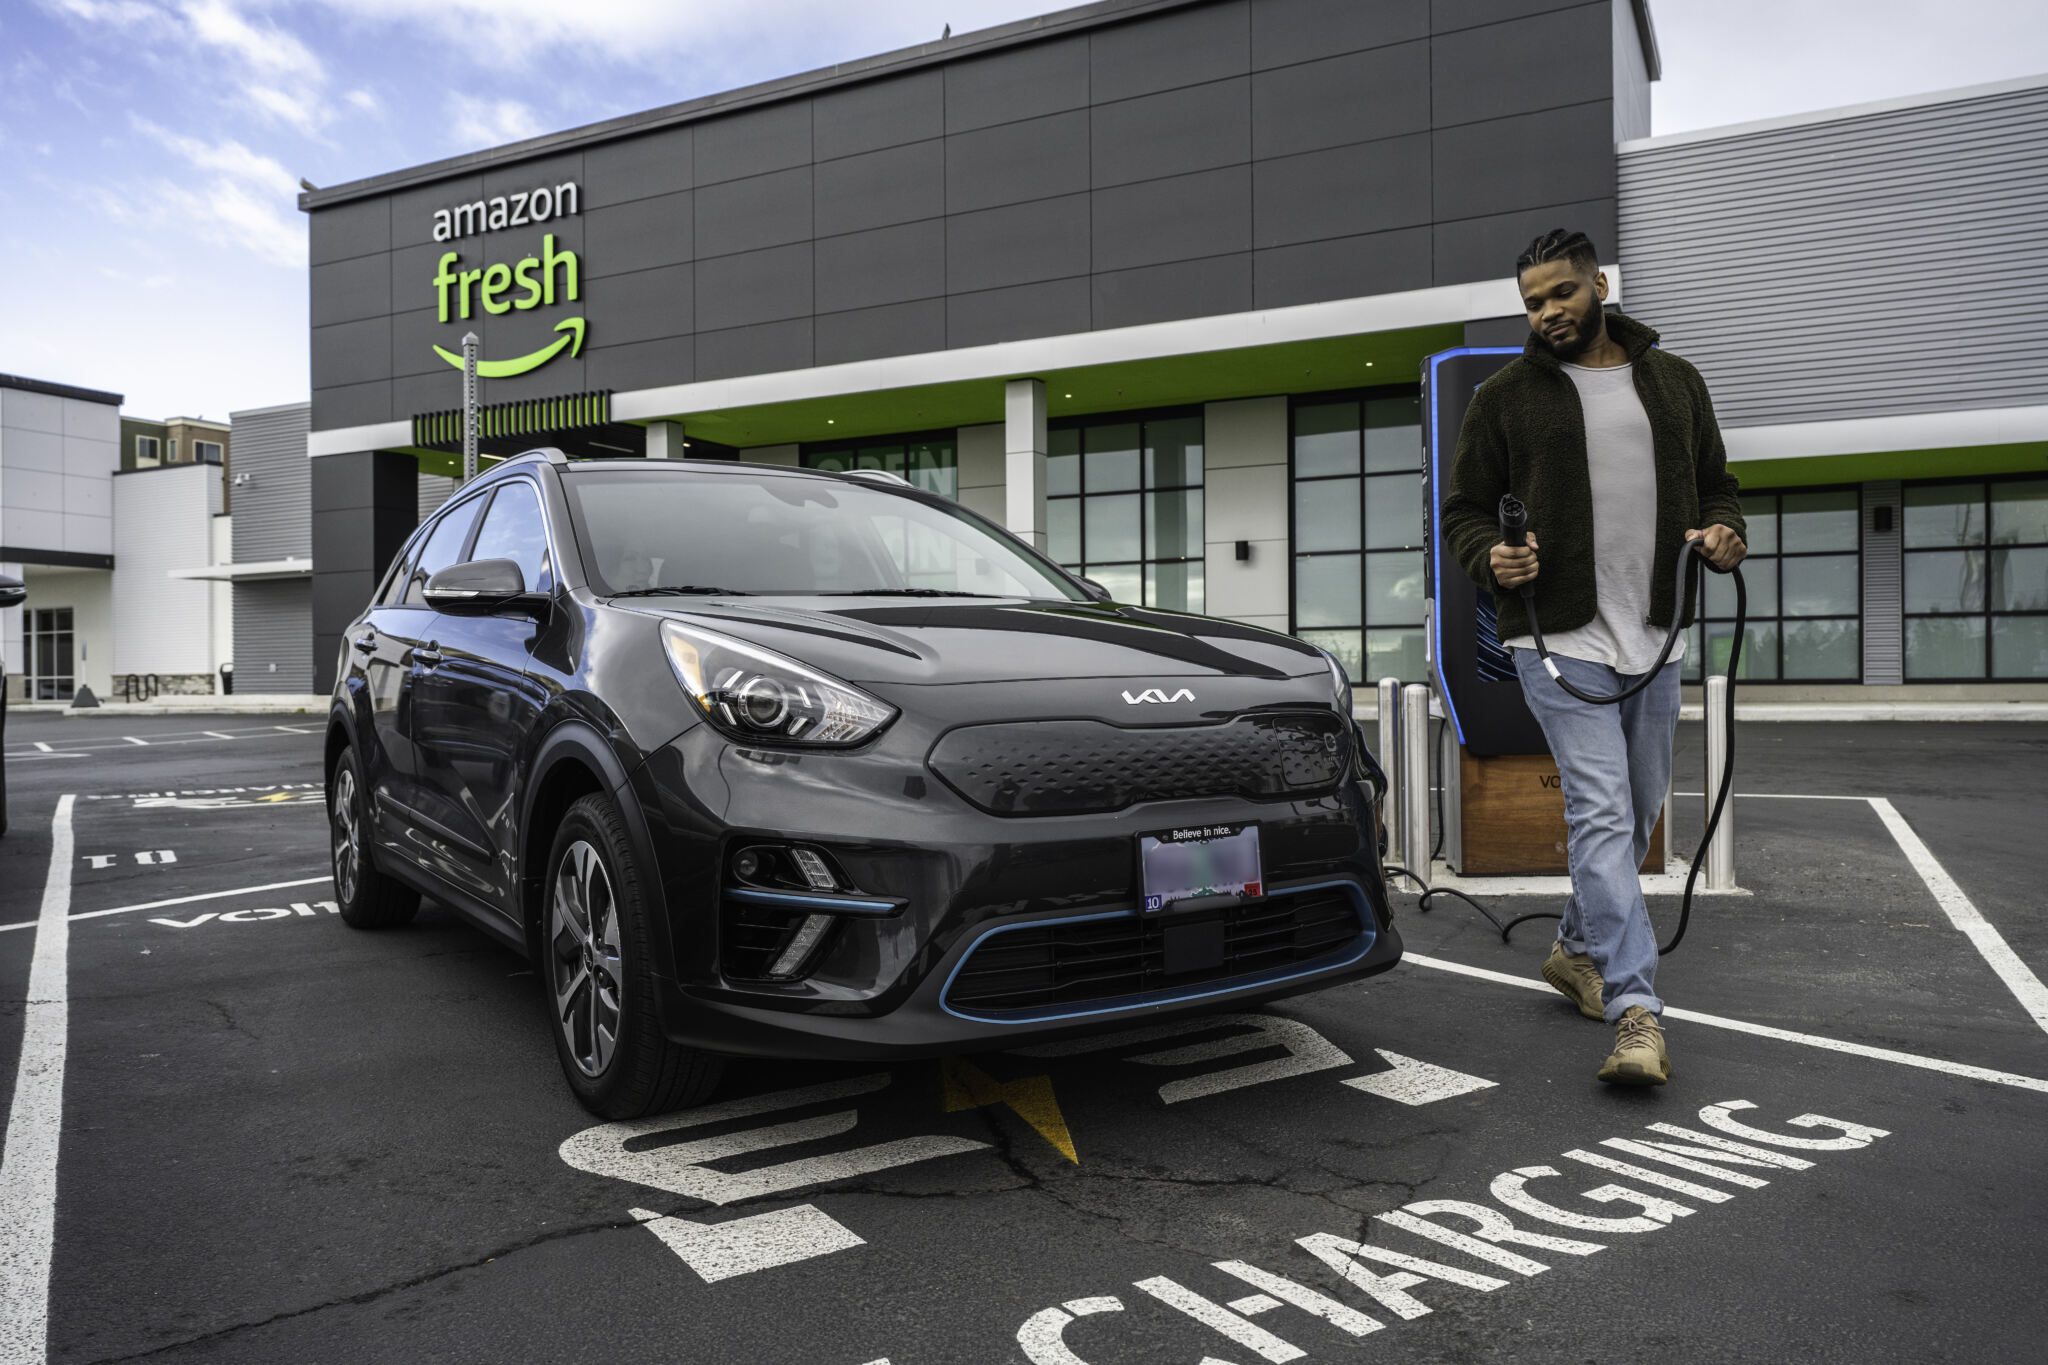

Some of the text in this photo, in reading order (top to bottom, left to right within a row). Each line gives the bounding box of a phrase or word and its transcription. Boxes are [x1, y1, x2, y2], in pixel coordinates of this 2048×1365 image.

[432, 181, 578, 242] amazon
[432, 234, 578, 323] fresh
[1121, 688, 1196, 705] KIA
[1172, 826, 1232, 840] Believe in nice.
[1147, 896, 1160, 910] 10
